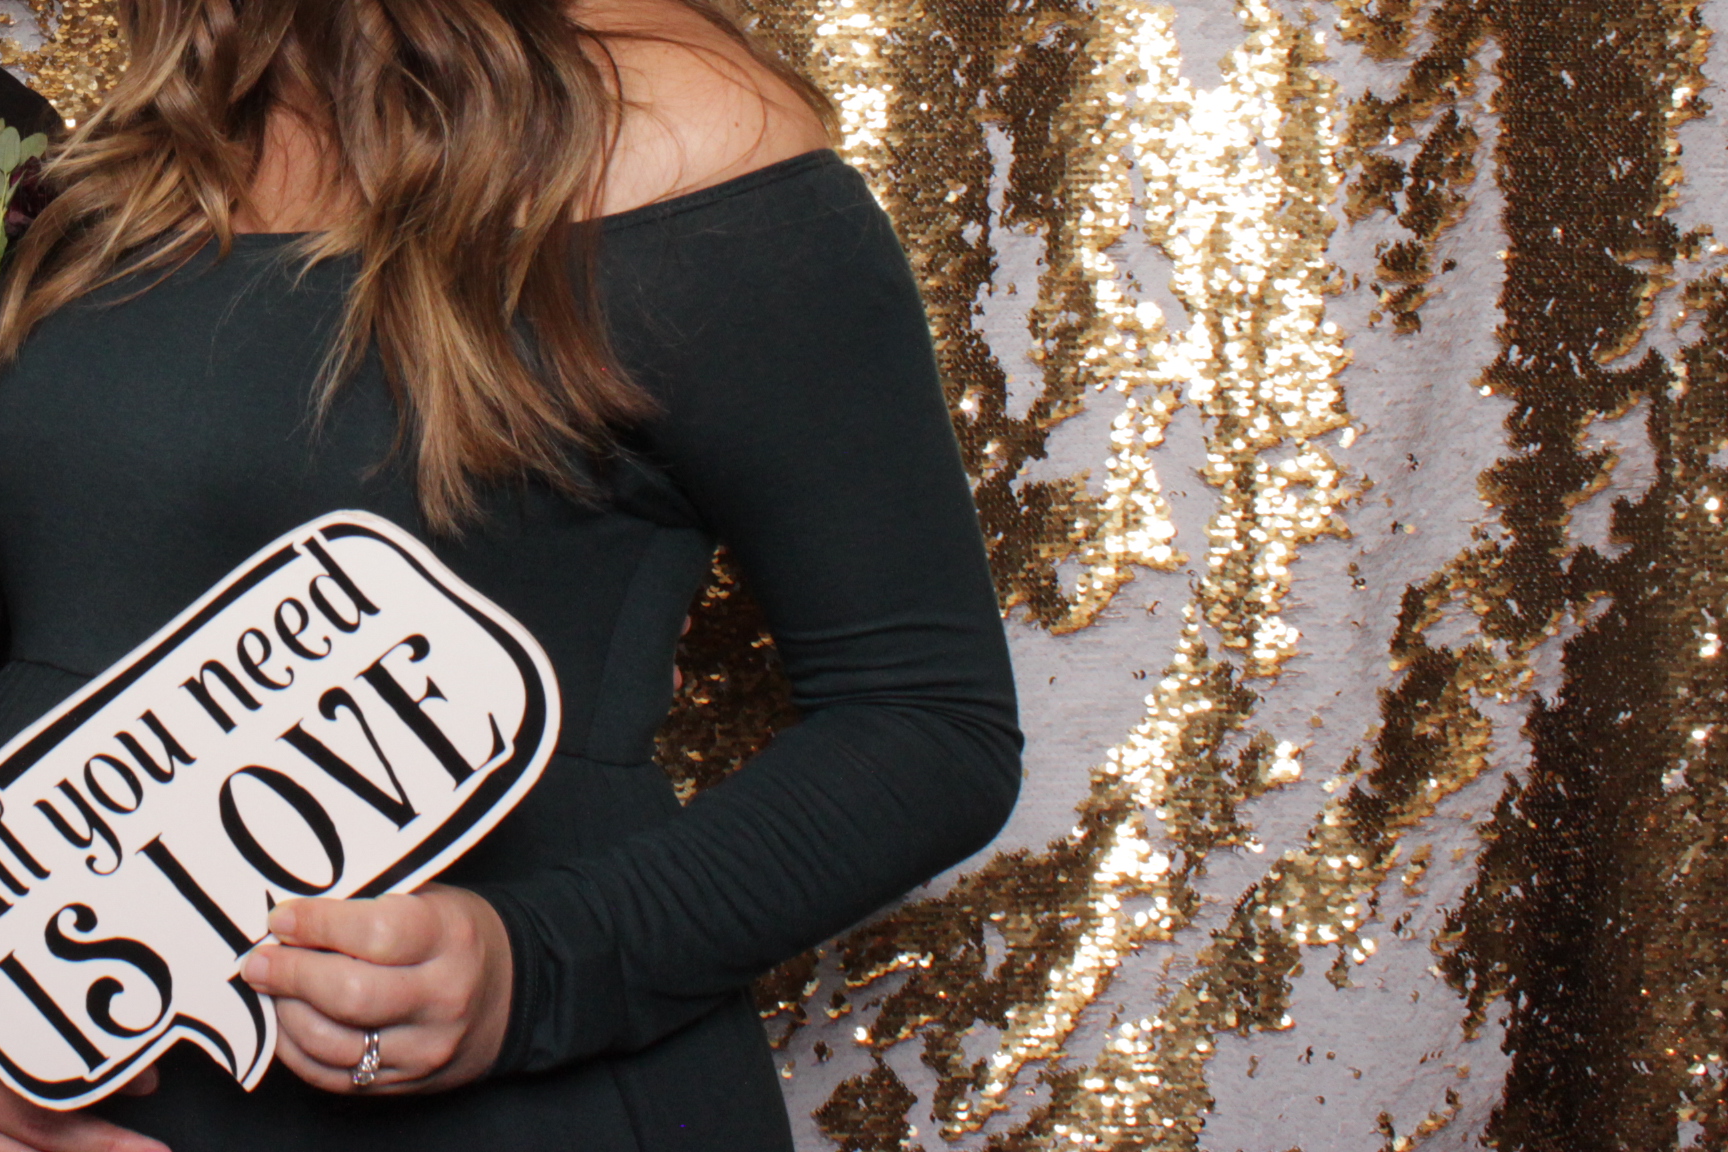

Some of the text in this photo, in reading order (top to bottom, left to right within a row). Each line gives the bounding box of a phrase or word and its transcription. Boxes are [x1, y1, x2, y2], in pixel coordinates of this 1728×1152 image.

[33, 709, 197, 876] you
[178, 536, 381, 735] need
[134, 633, 507, 960] LOVE
